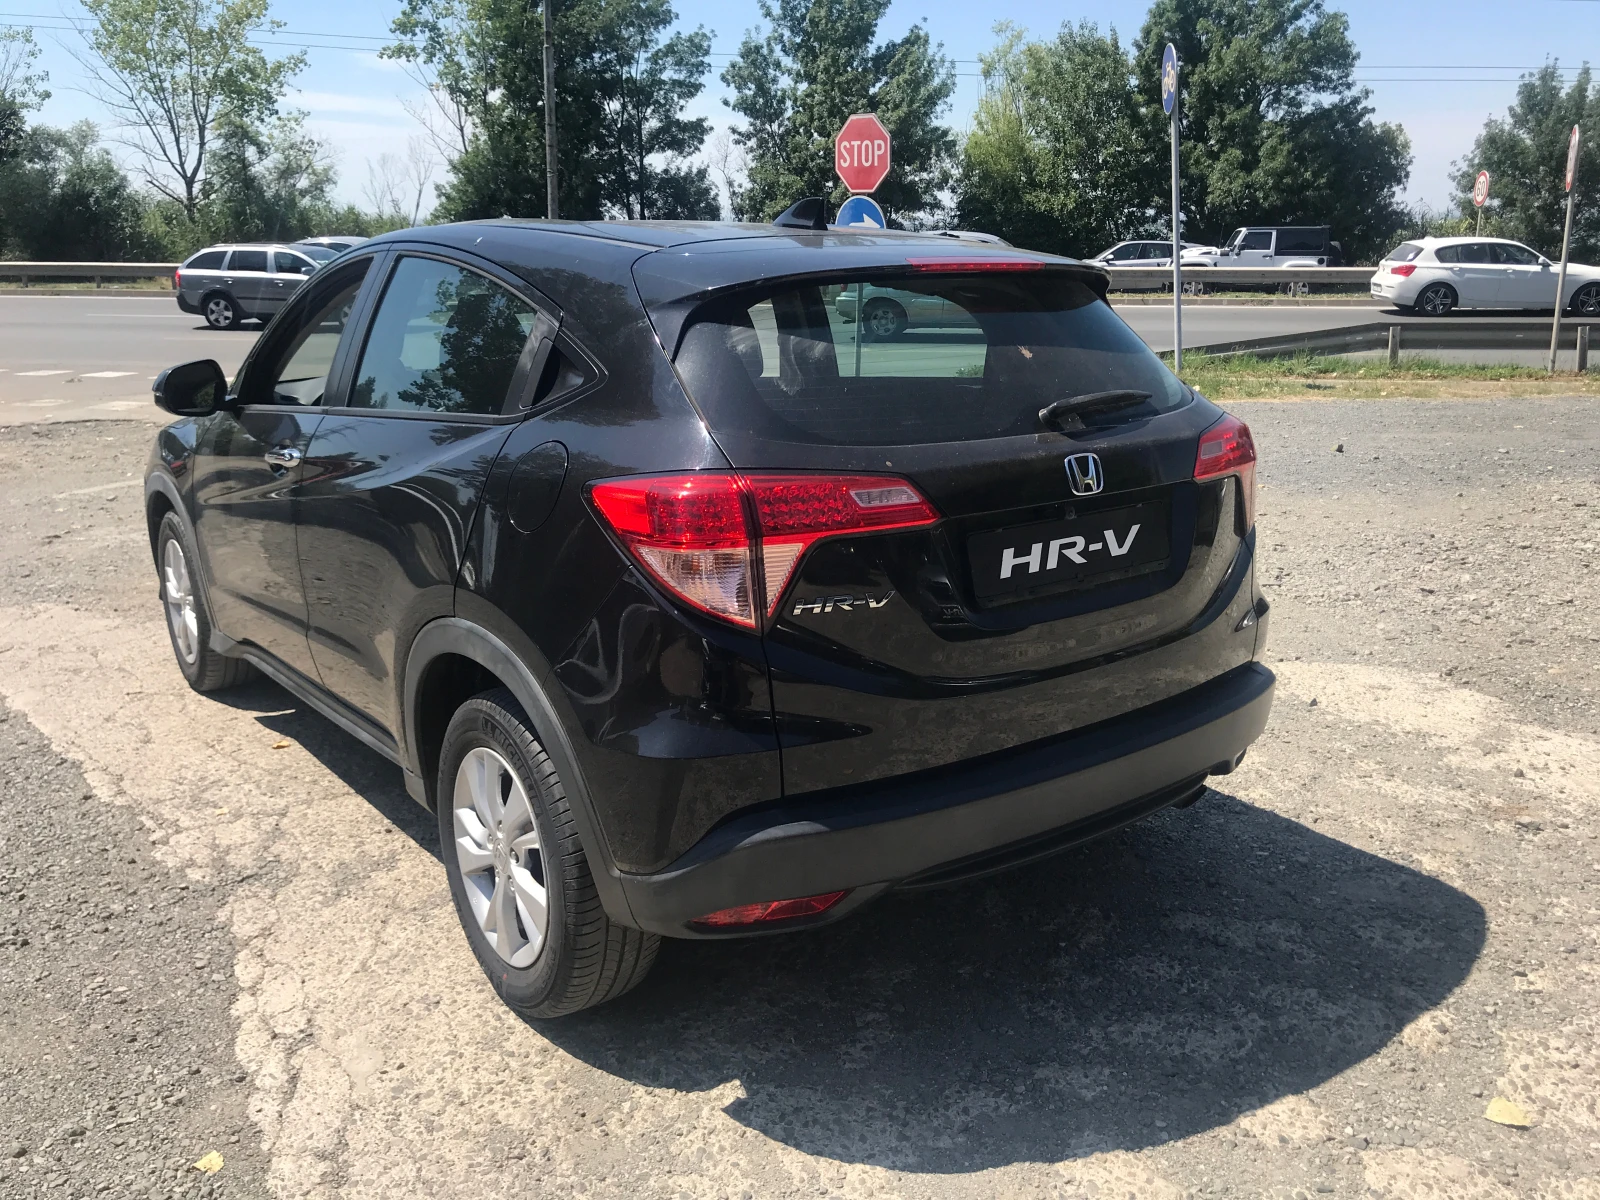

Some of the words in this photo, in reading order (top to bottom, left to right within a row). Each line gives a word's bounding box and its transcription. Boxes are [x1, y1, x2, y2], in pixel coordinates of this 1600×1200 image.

[840, 139, 885, 168] STOP
[1476, 180, 1486, 197] 60
[1000, 523, 1141, 579] HR-V
[792, 590, 896, 616] HR-V
